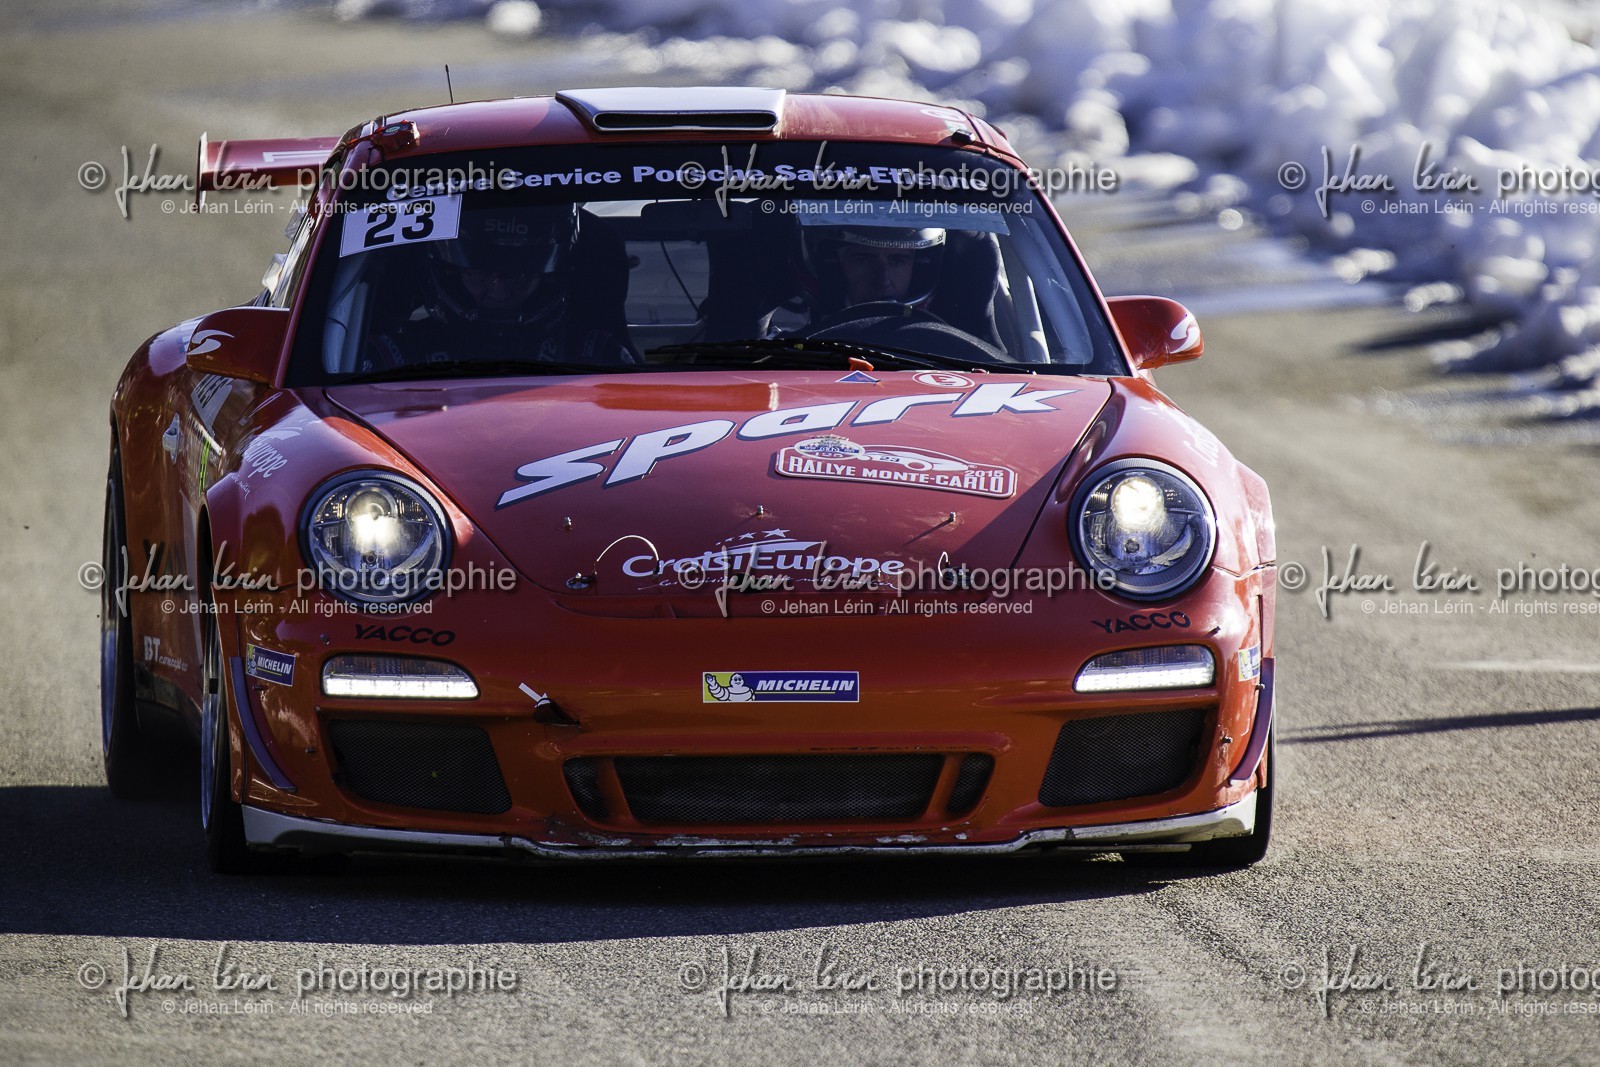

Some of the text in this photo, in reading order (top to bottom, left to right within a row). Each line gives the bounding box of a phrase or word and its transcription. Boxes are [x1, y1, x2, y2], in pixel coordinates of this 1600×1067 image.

[386, 176, 492, 201] Centre
[502, 168, 622, 188] Service
[632, 165, 765, 183] Porsche
[363, 200, 436, 249] 23
[788, 455, 1003, 493] RALLYE MONTE-CARLO
[964, 470, 1004, 478] 2015
[1091, 611, 1191, 633] YACCO
[354, 623, 456, 647] YACCO
[257, 656, 292, 675] MICHELIN
[756, 679, 855, 691] MICHELIN
